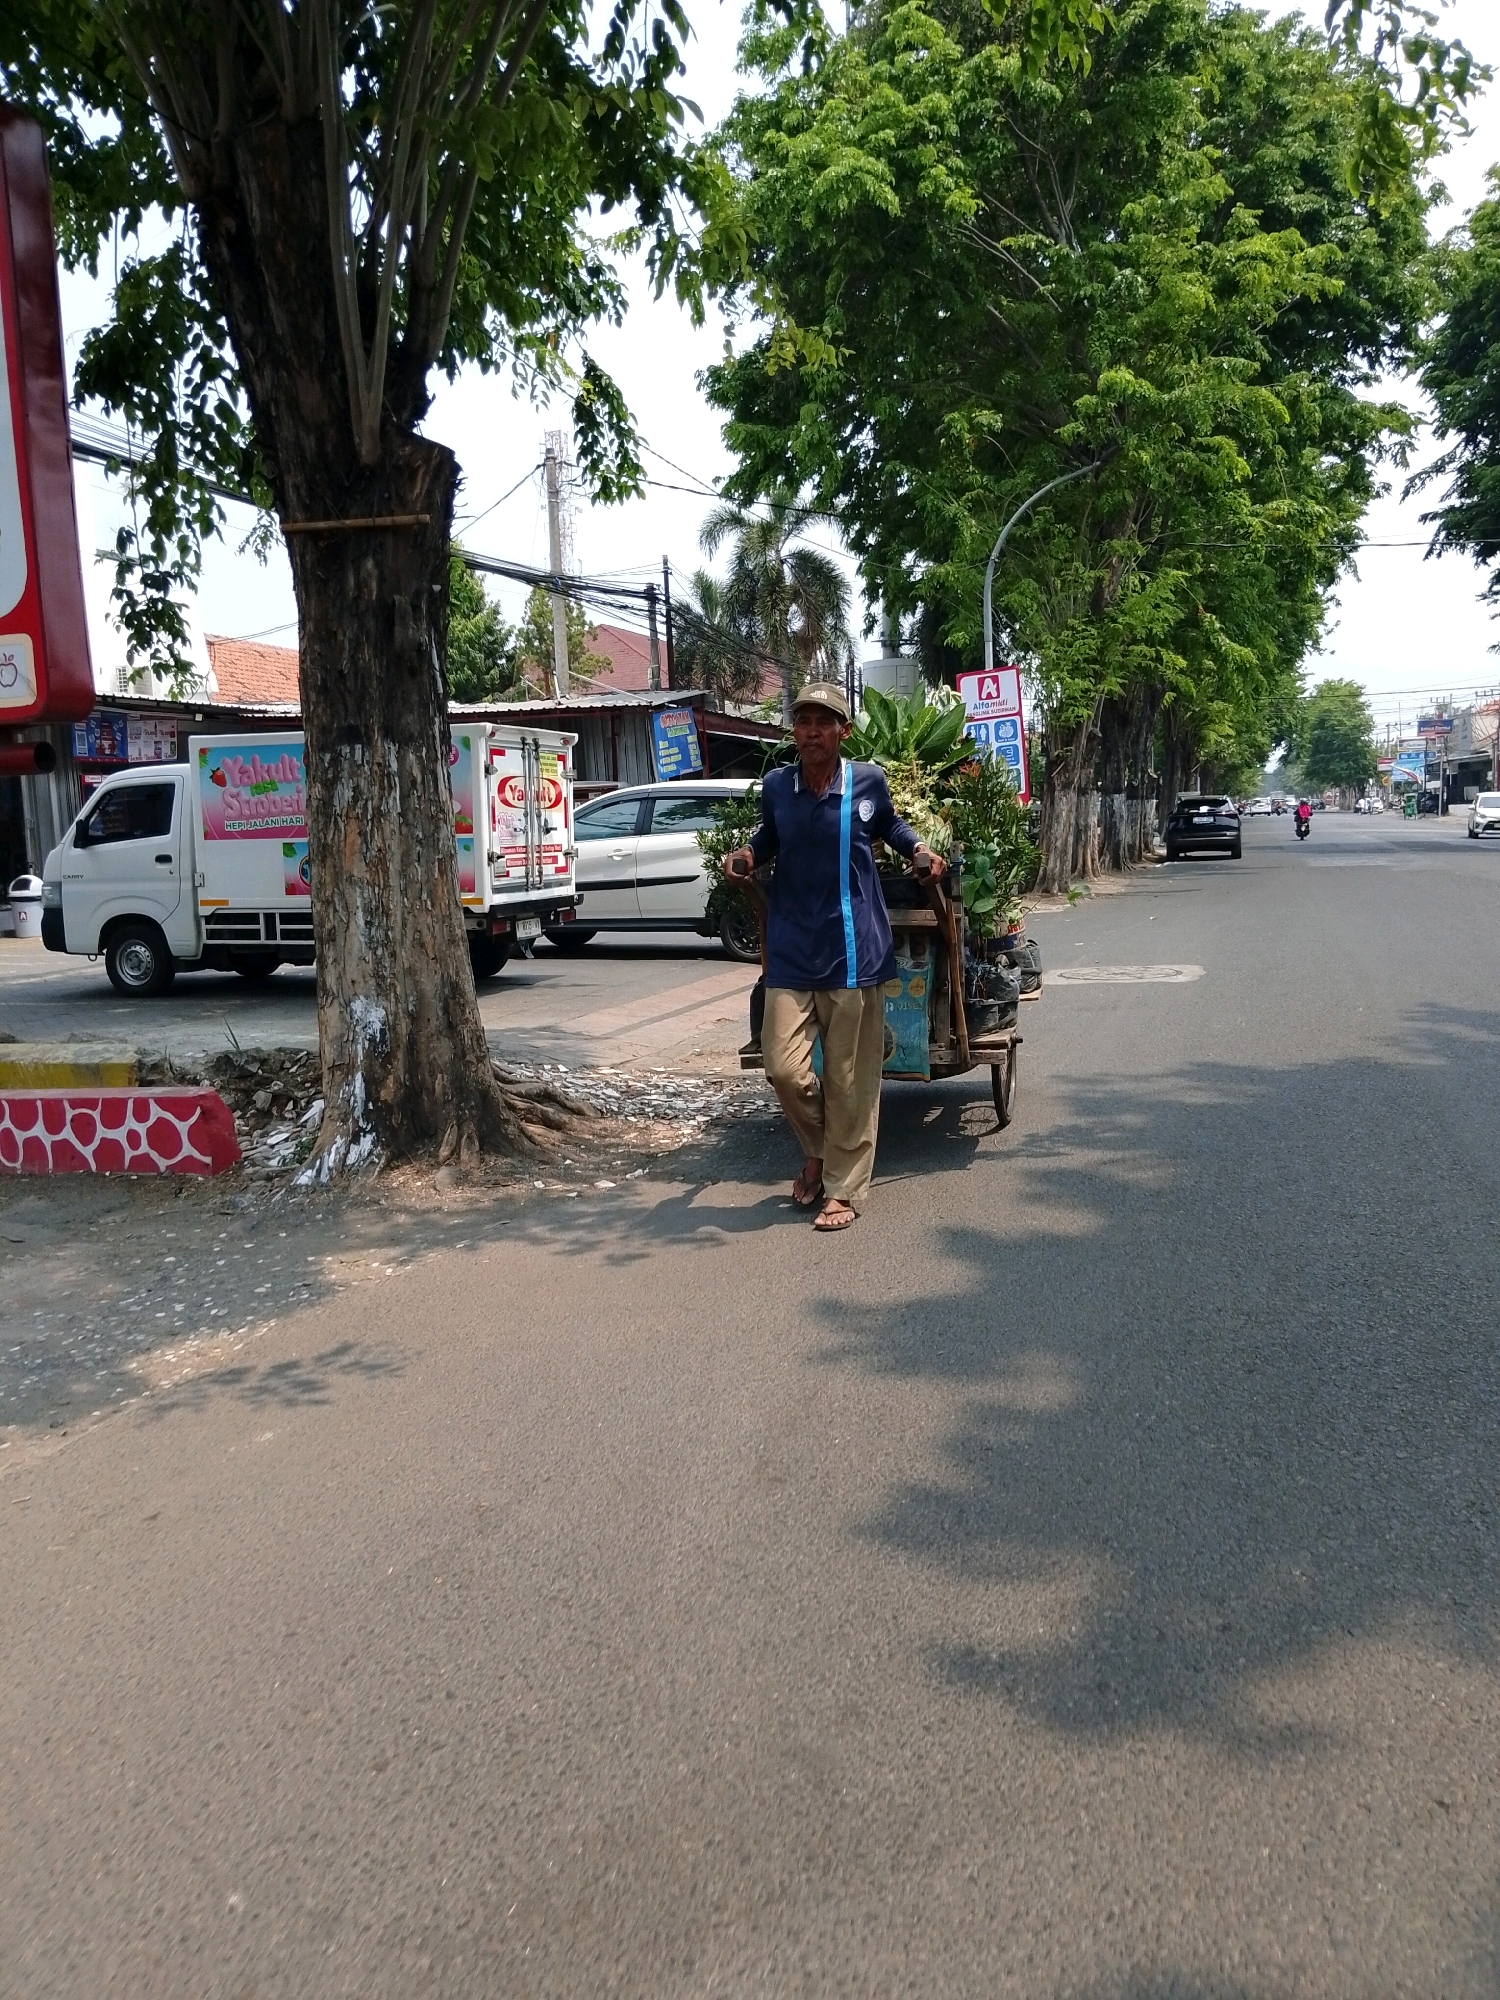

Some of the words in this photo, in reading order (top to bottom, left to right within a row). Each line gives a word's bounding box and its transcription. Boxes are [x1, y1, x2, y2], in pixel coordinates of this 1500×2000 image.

[973, 699, 1008, 710] Alfamidi
[222, 754, 301, 787] Yakult
[223, 784, 303, 820] Stroberi
[225, 822, 246, 831] HEPI
[248, 818, 280, 829] JALANI
[282, 816, 304, 826] HARI
